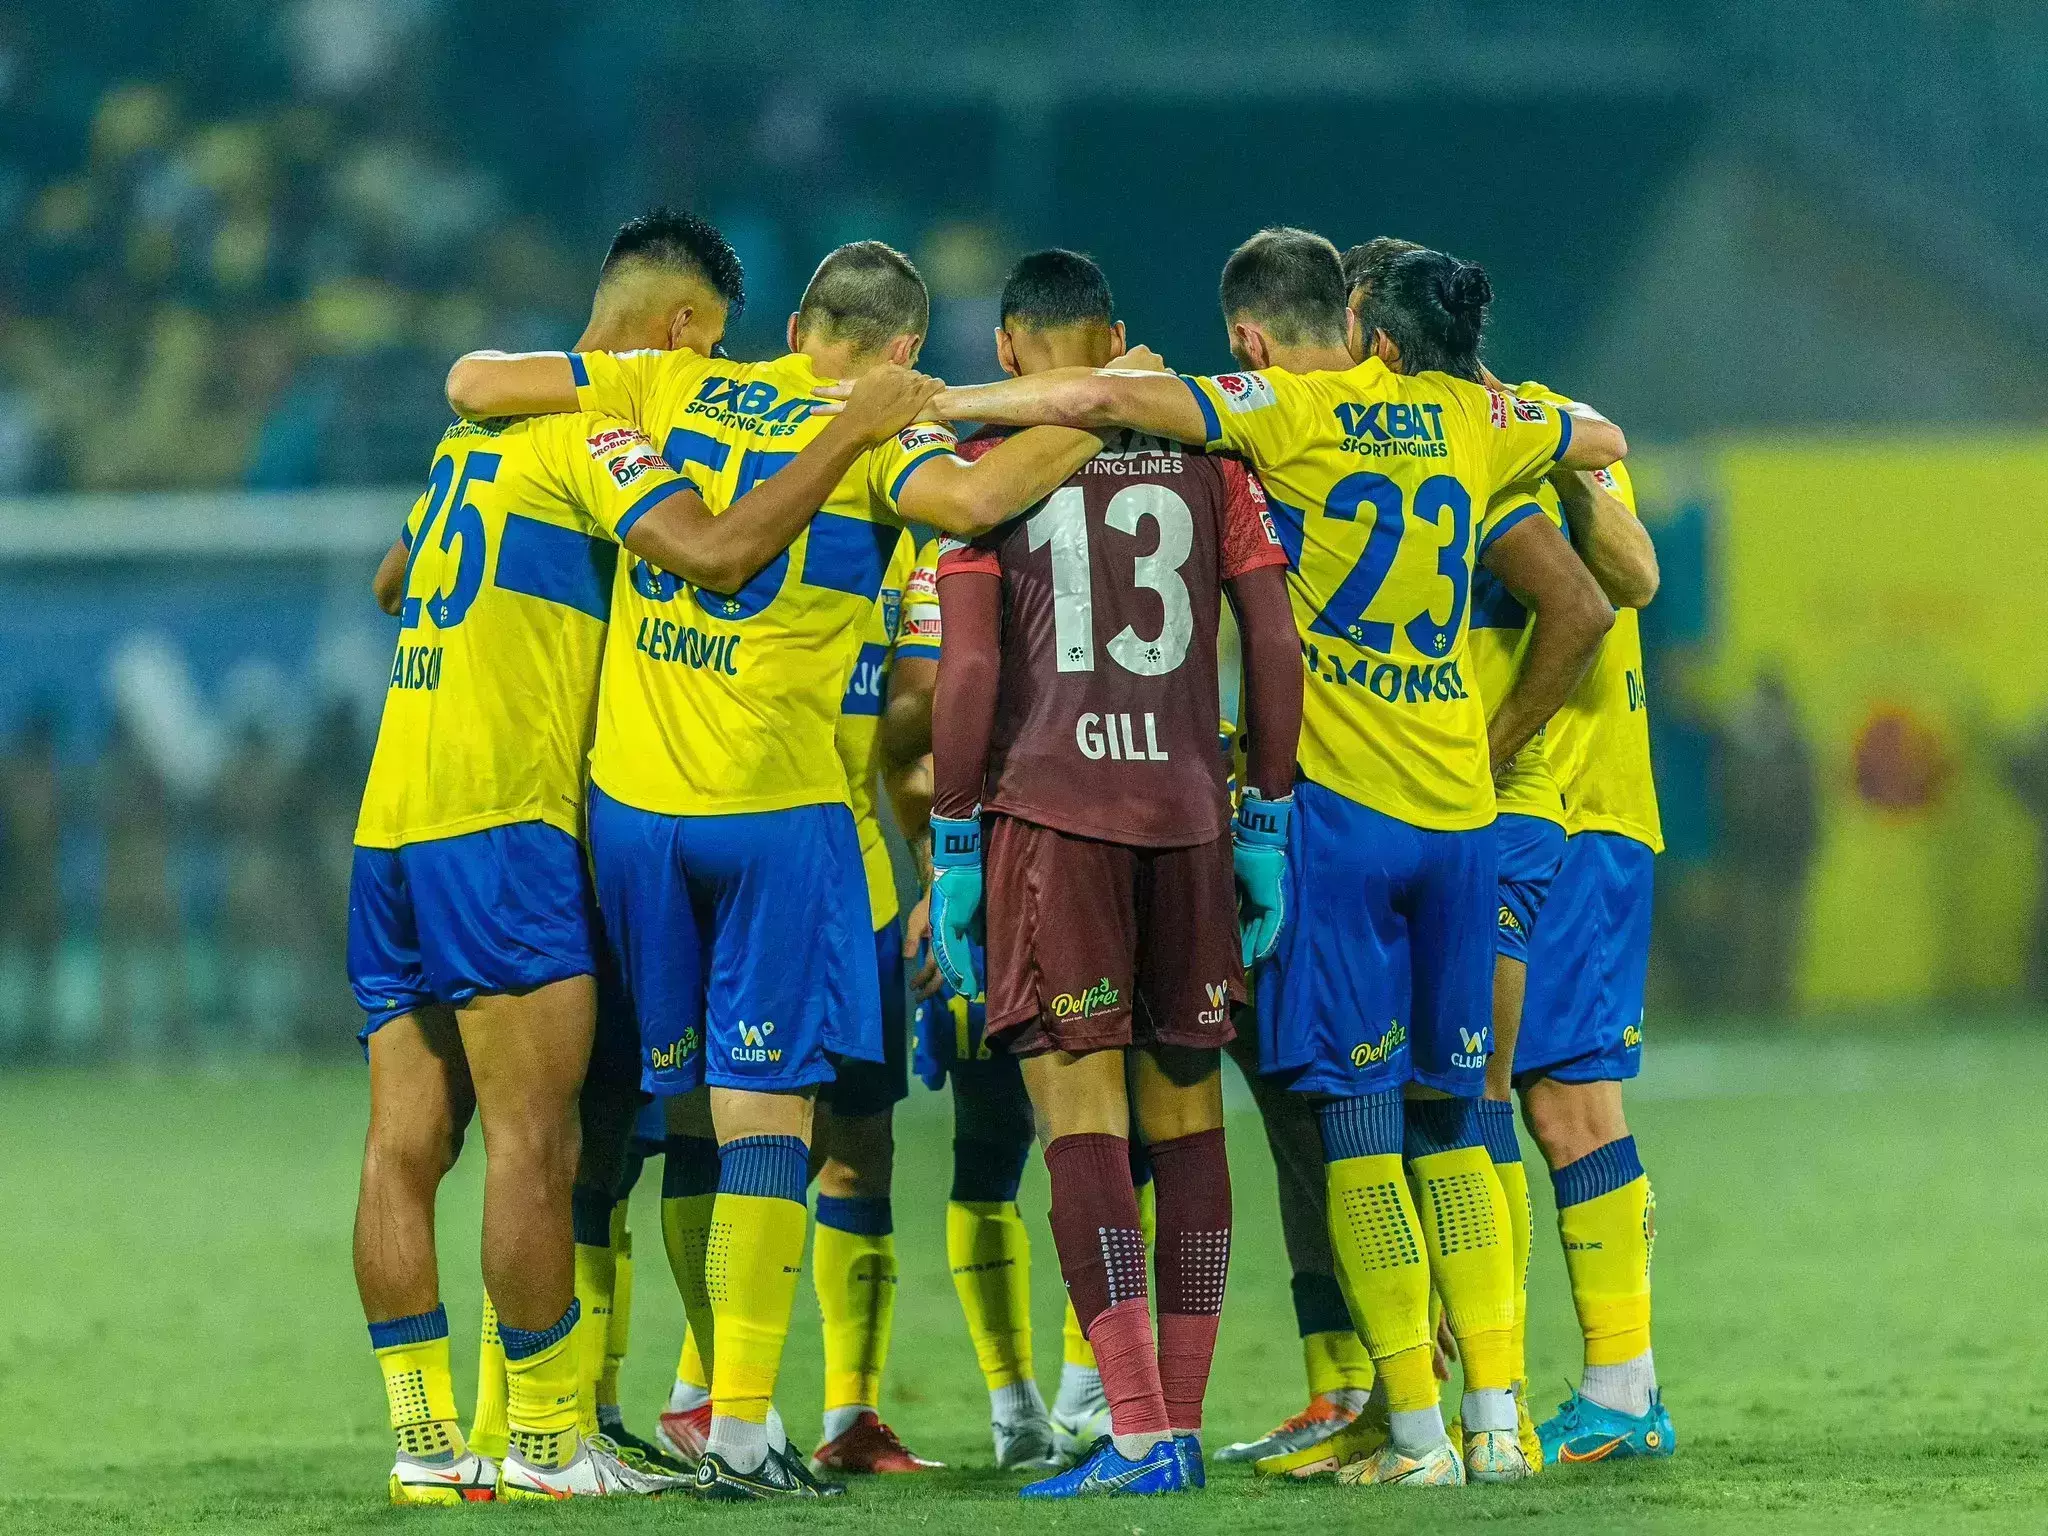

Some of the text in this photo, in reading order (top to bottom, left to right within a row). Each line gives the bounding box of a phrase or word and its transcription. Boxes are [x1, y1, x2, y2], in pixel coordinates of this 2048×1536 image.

[1333, 401, 1445, 442] 1XBAT
[399, 451, 503, 630] 25
[1306, 471, 1472, 659] 23
[1026, 484, 1194, 677] 13
[637, 617, 741, 676] LESKOVIC
[1076, 712, 1169, 762] GILL
[1051, 987, 1119, 1018] Delfrez
[731, 1047, 782, 1062] CLUB W
[1351, 1026, 1406, 1067] Delfrez
